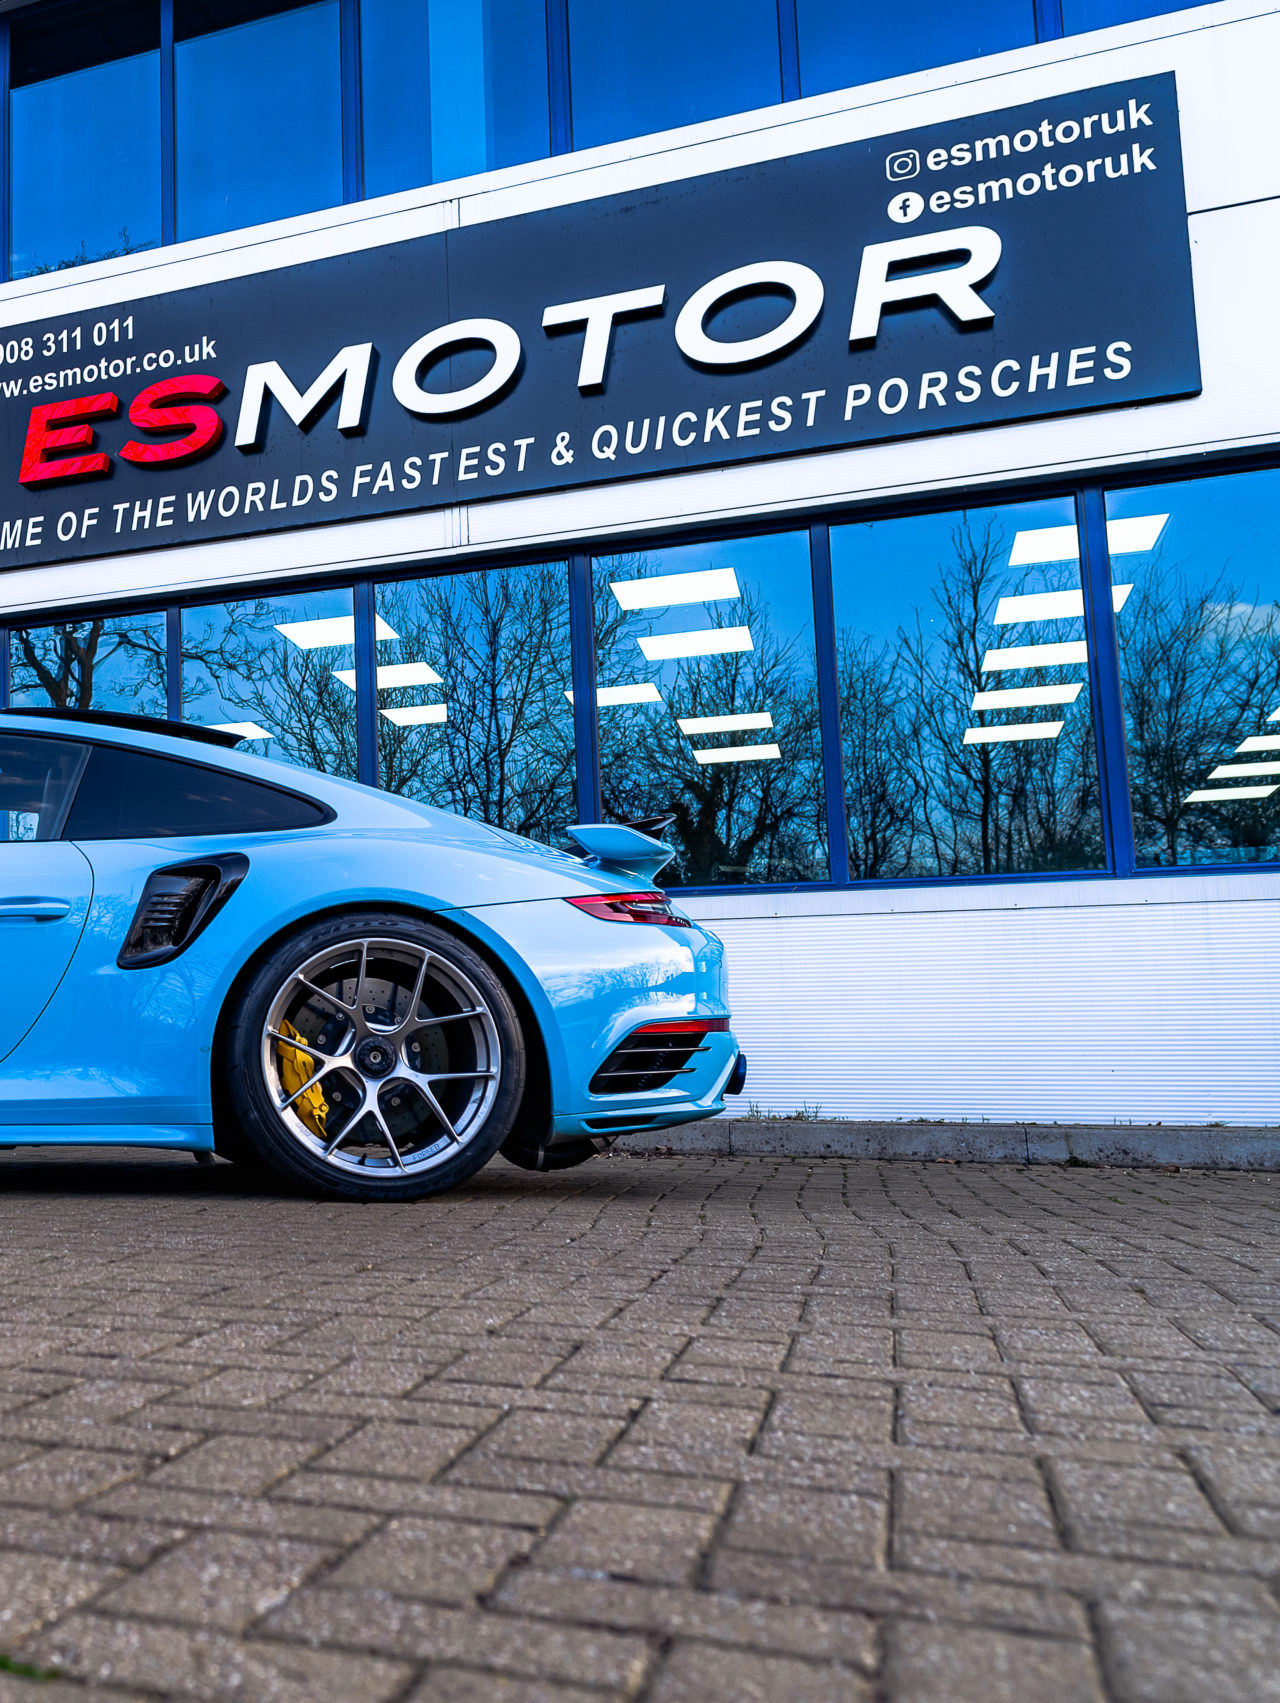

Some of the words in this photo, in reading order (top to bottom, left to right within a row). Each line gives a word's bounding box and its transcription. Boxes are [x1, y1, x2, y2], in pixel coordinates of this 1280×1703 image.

[926, 98, 1154, 171] esmotoruk
[929, 142, 1157, 214] esmotoruk
[19, 225, 1002, 487] ESMOTOR
[42, 326, 82, 357] 311
[92, 315, 134, 347] 011
[56, 507, 100, 542] OF
[112, 495, 176, 534] THE
[186, 469, 339, 523] WORLDS
[351, 436, 535, 498] FASTEST
[550, 431, 575, 466] &
[591, 389, 826, 461] QUICKEST
[843, 340, 1132, 421] PORSCHES
[412, 1143, 441, 1161] FORGED
